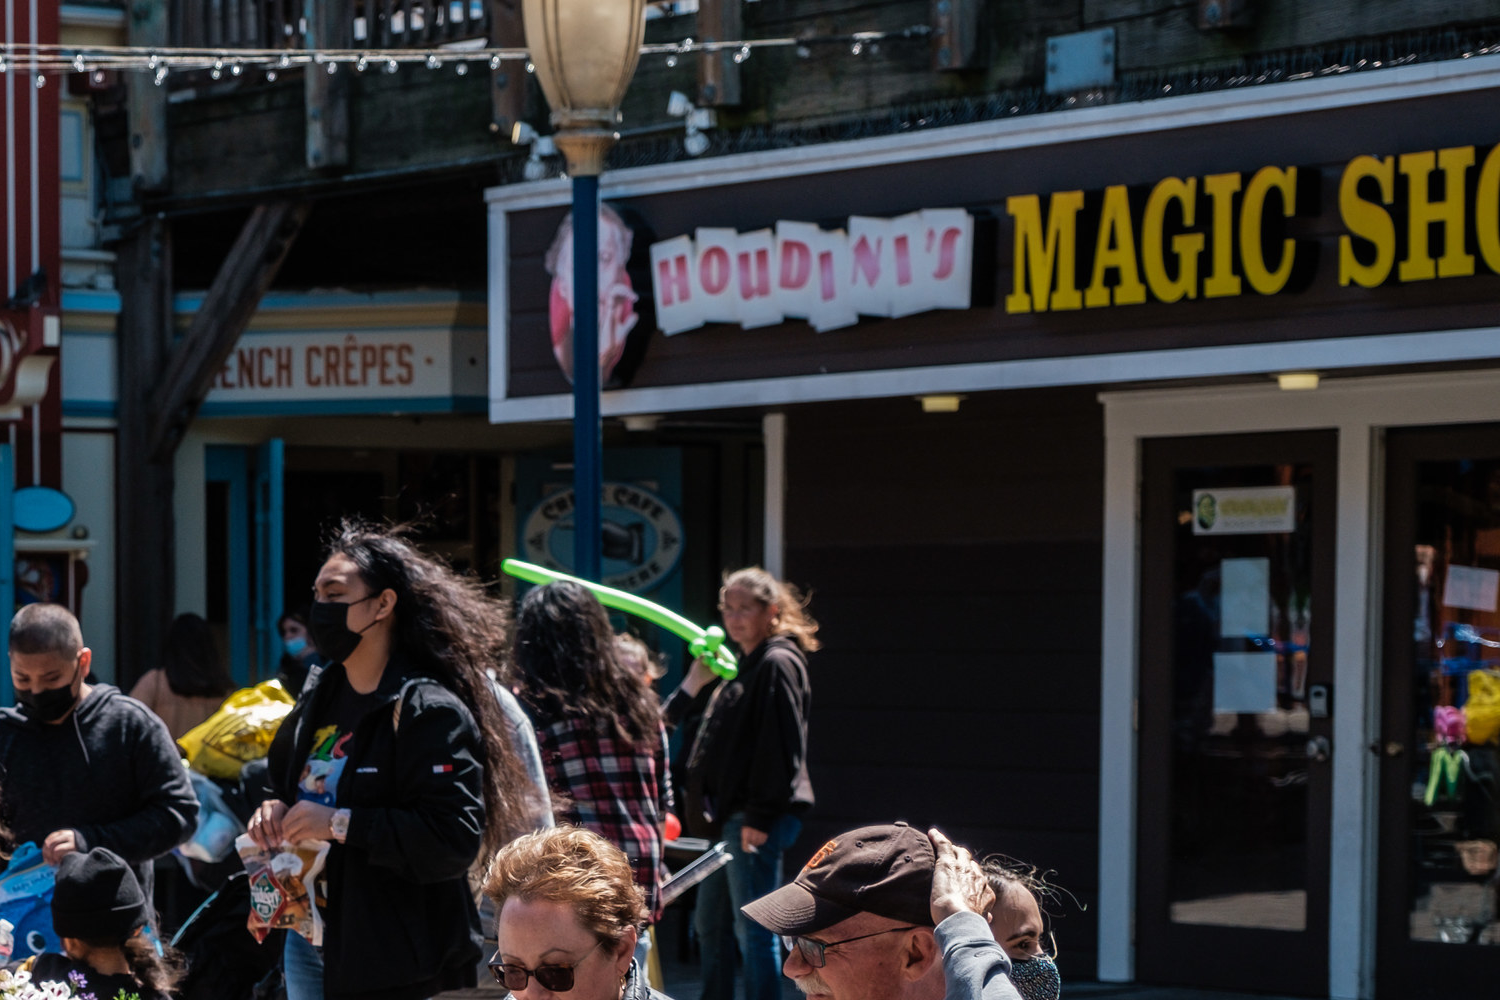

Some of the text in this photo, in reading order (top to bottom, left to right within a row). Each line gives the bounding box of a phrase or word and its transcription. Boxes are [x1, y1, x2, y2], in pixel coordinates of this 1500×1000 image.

[1006, 165, 1298, 314] MAGIC
[211, 333, 414, 389] ENCH CRÊPES
